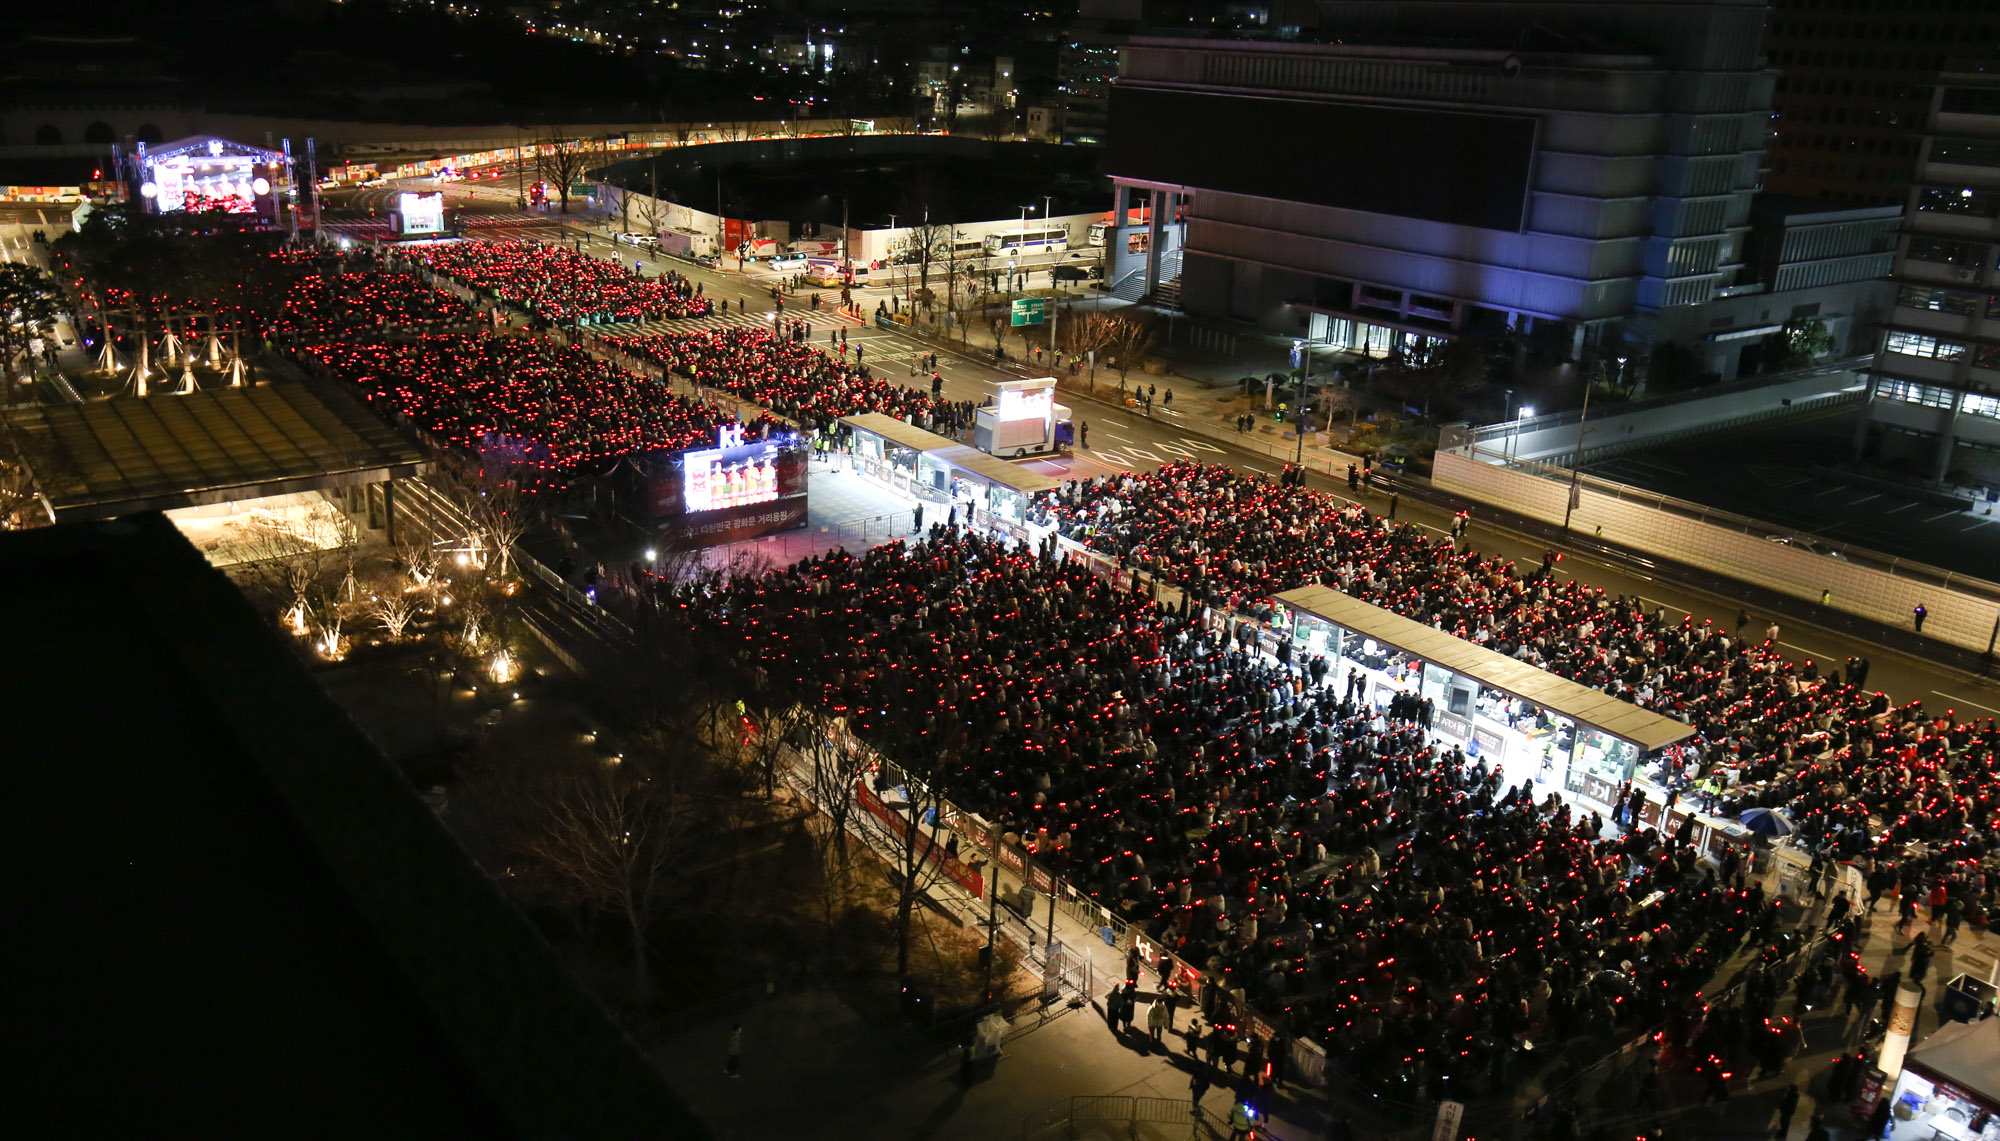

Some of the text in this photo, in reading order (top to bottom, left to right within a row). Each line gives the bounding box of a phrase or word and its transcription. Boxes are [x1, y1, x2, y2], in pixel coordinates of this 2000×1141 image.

[720, 424, 746, 449] kt
[701, 521, 731, 534] 대한민국
[733, 516, 756, 529] 광화문
[758, 510, 788, 525] 거리응원
[1008, 851, 1022, 868] KFA
[1135, 934, 1154, 962] kt
